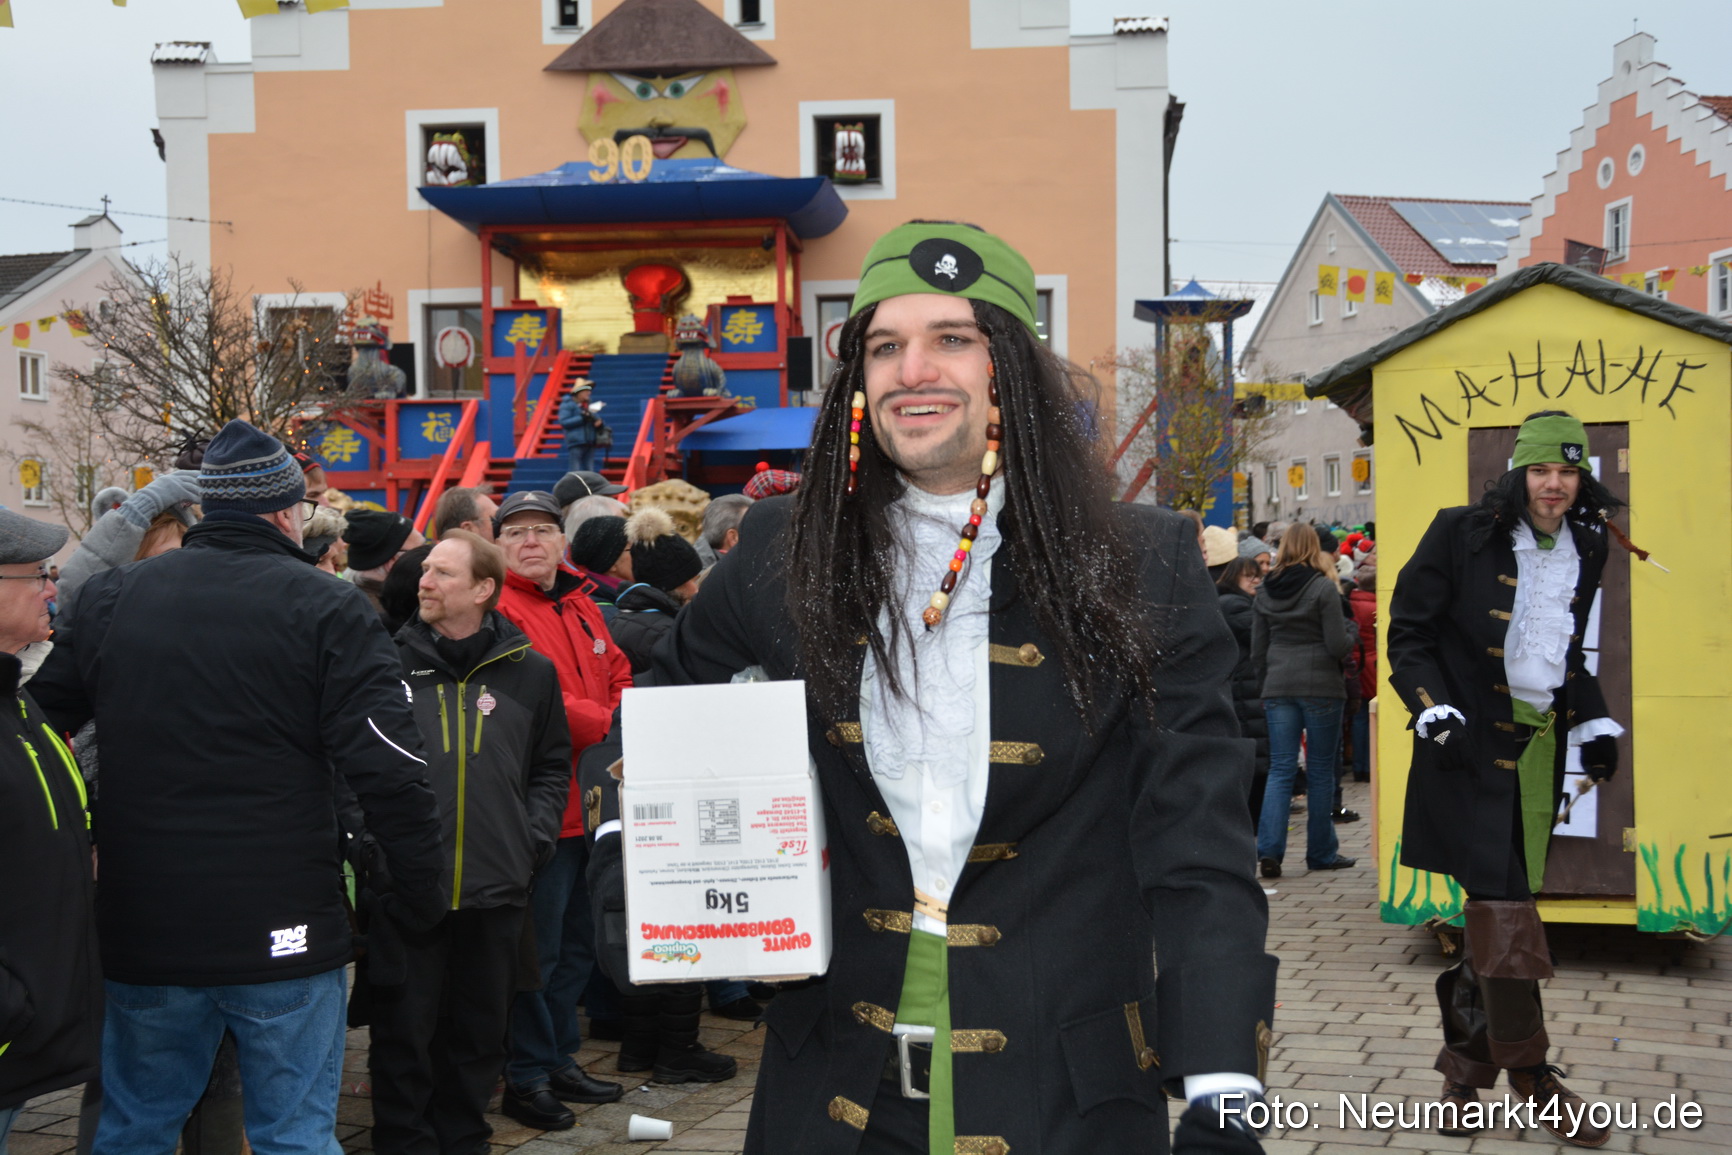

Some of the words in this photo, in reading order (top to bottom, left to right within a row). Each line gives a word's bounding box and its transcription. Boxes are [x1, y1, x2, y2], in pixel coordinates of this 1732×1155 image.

[588, 135, 653, 183] 90
[780, 840, 808, 856] Tise
[270, 925, 307, 944] TAO
[641, 917, 795, 940] BONBONMISCHUNG
[653, 942, 698, 956] Capico
[762, 932, 812, 952] BUNTE
